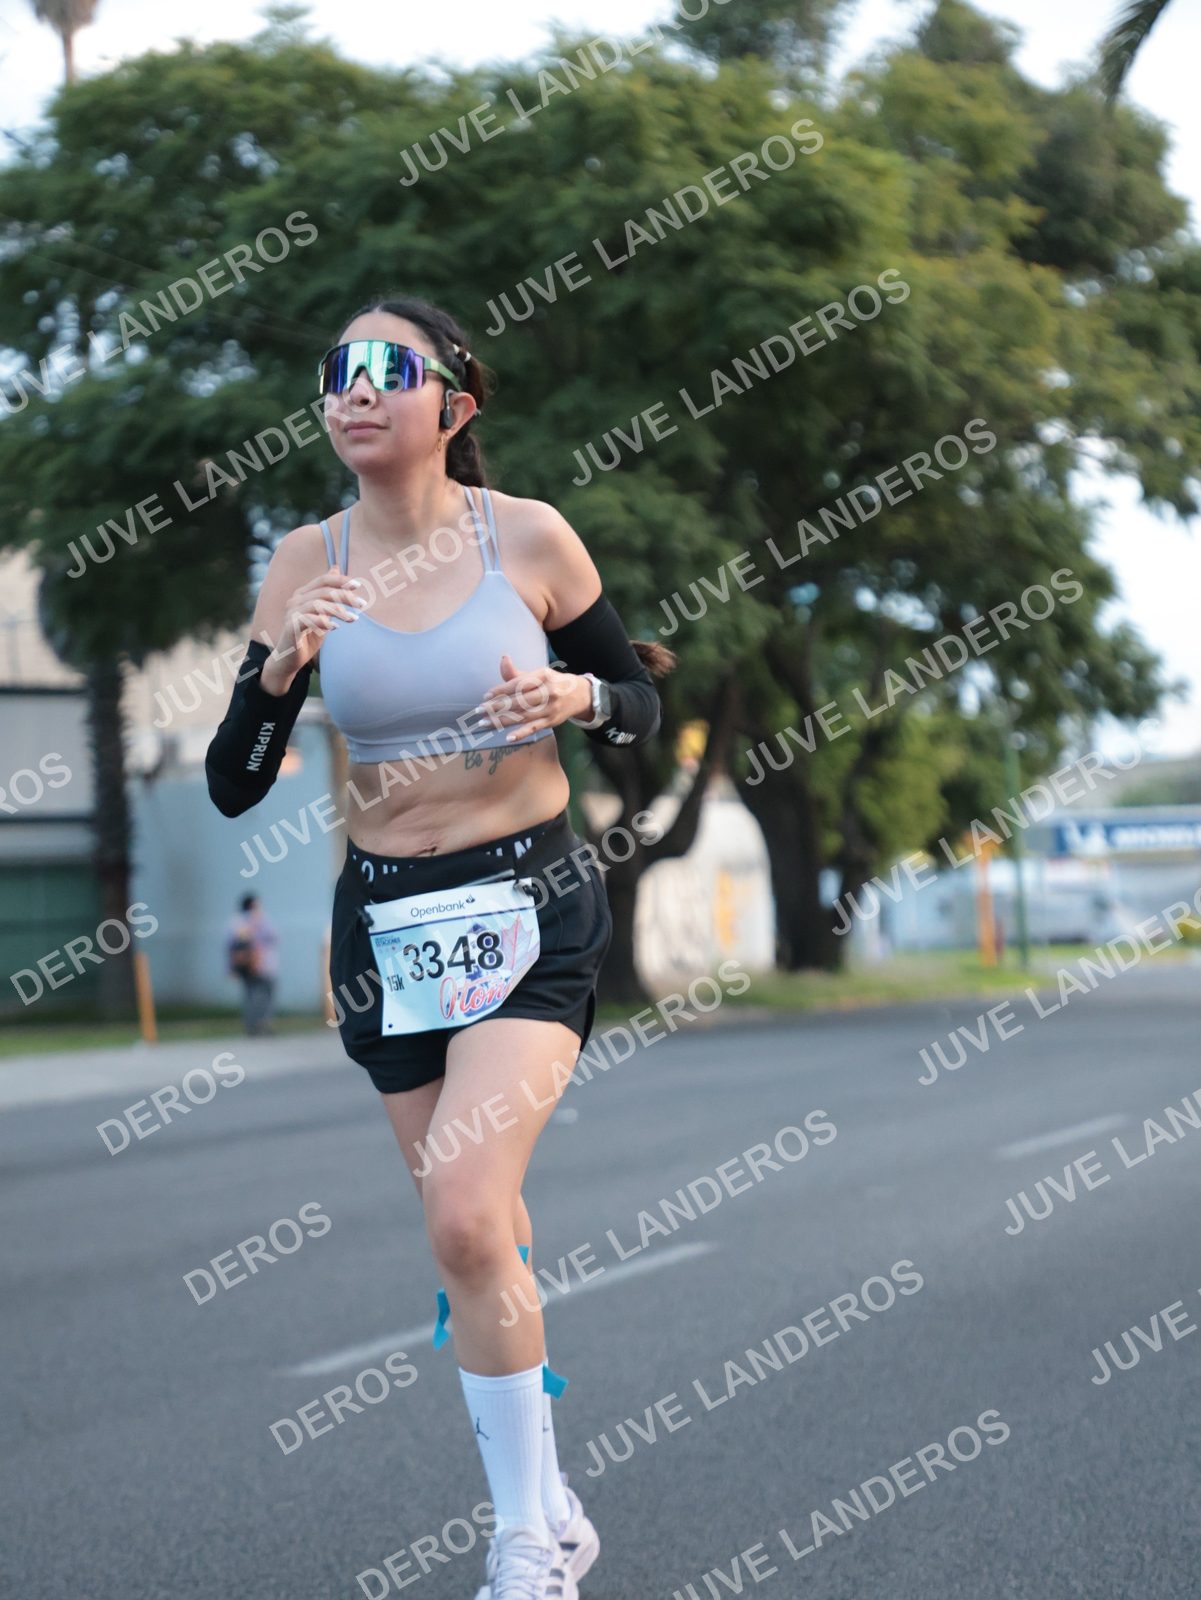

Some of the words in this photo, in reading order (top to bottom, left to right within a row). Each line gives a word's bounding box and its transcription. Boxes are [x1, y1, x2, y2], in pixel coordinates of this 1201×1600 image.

[246, 722, 276, 771] KIPRUN
[410, 900, 466, 919] Openbank
[403, 931, 504, 982] 3348
